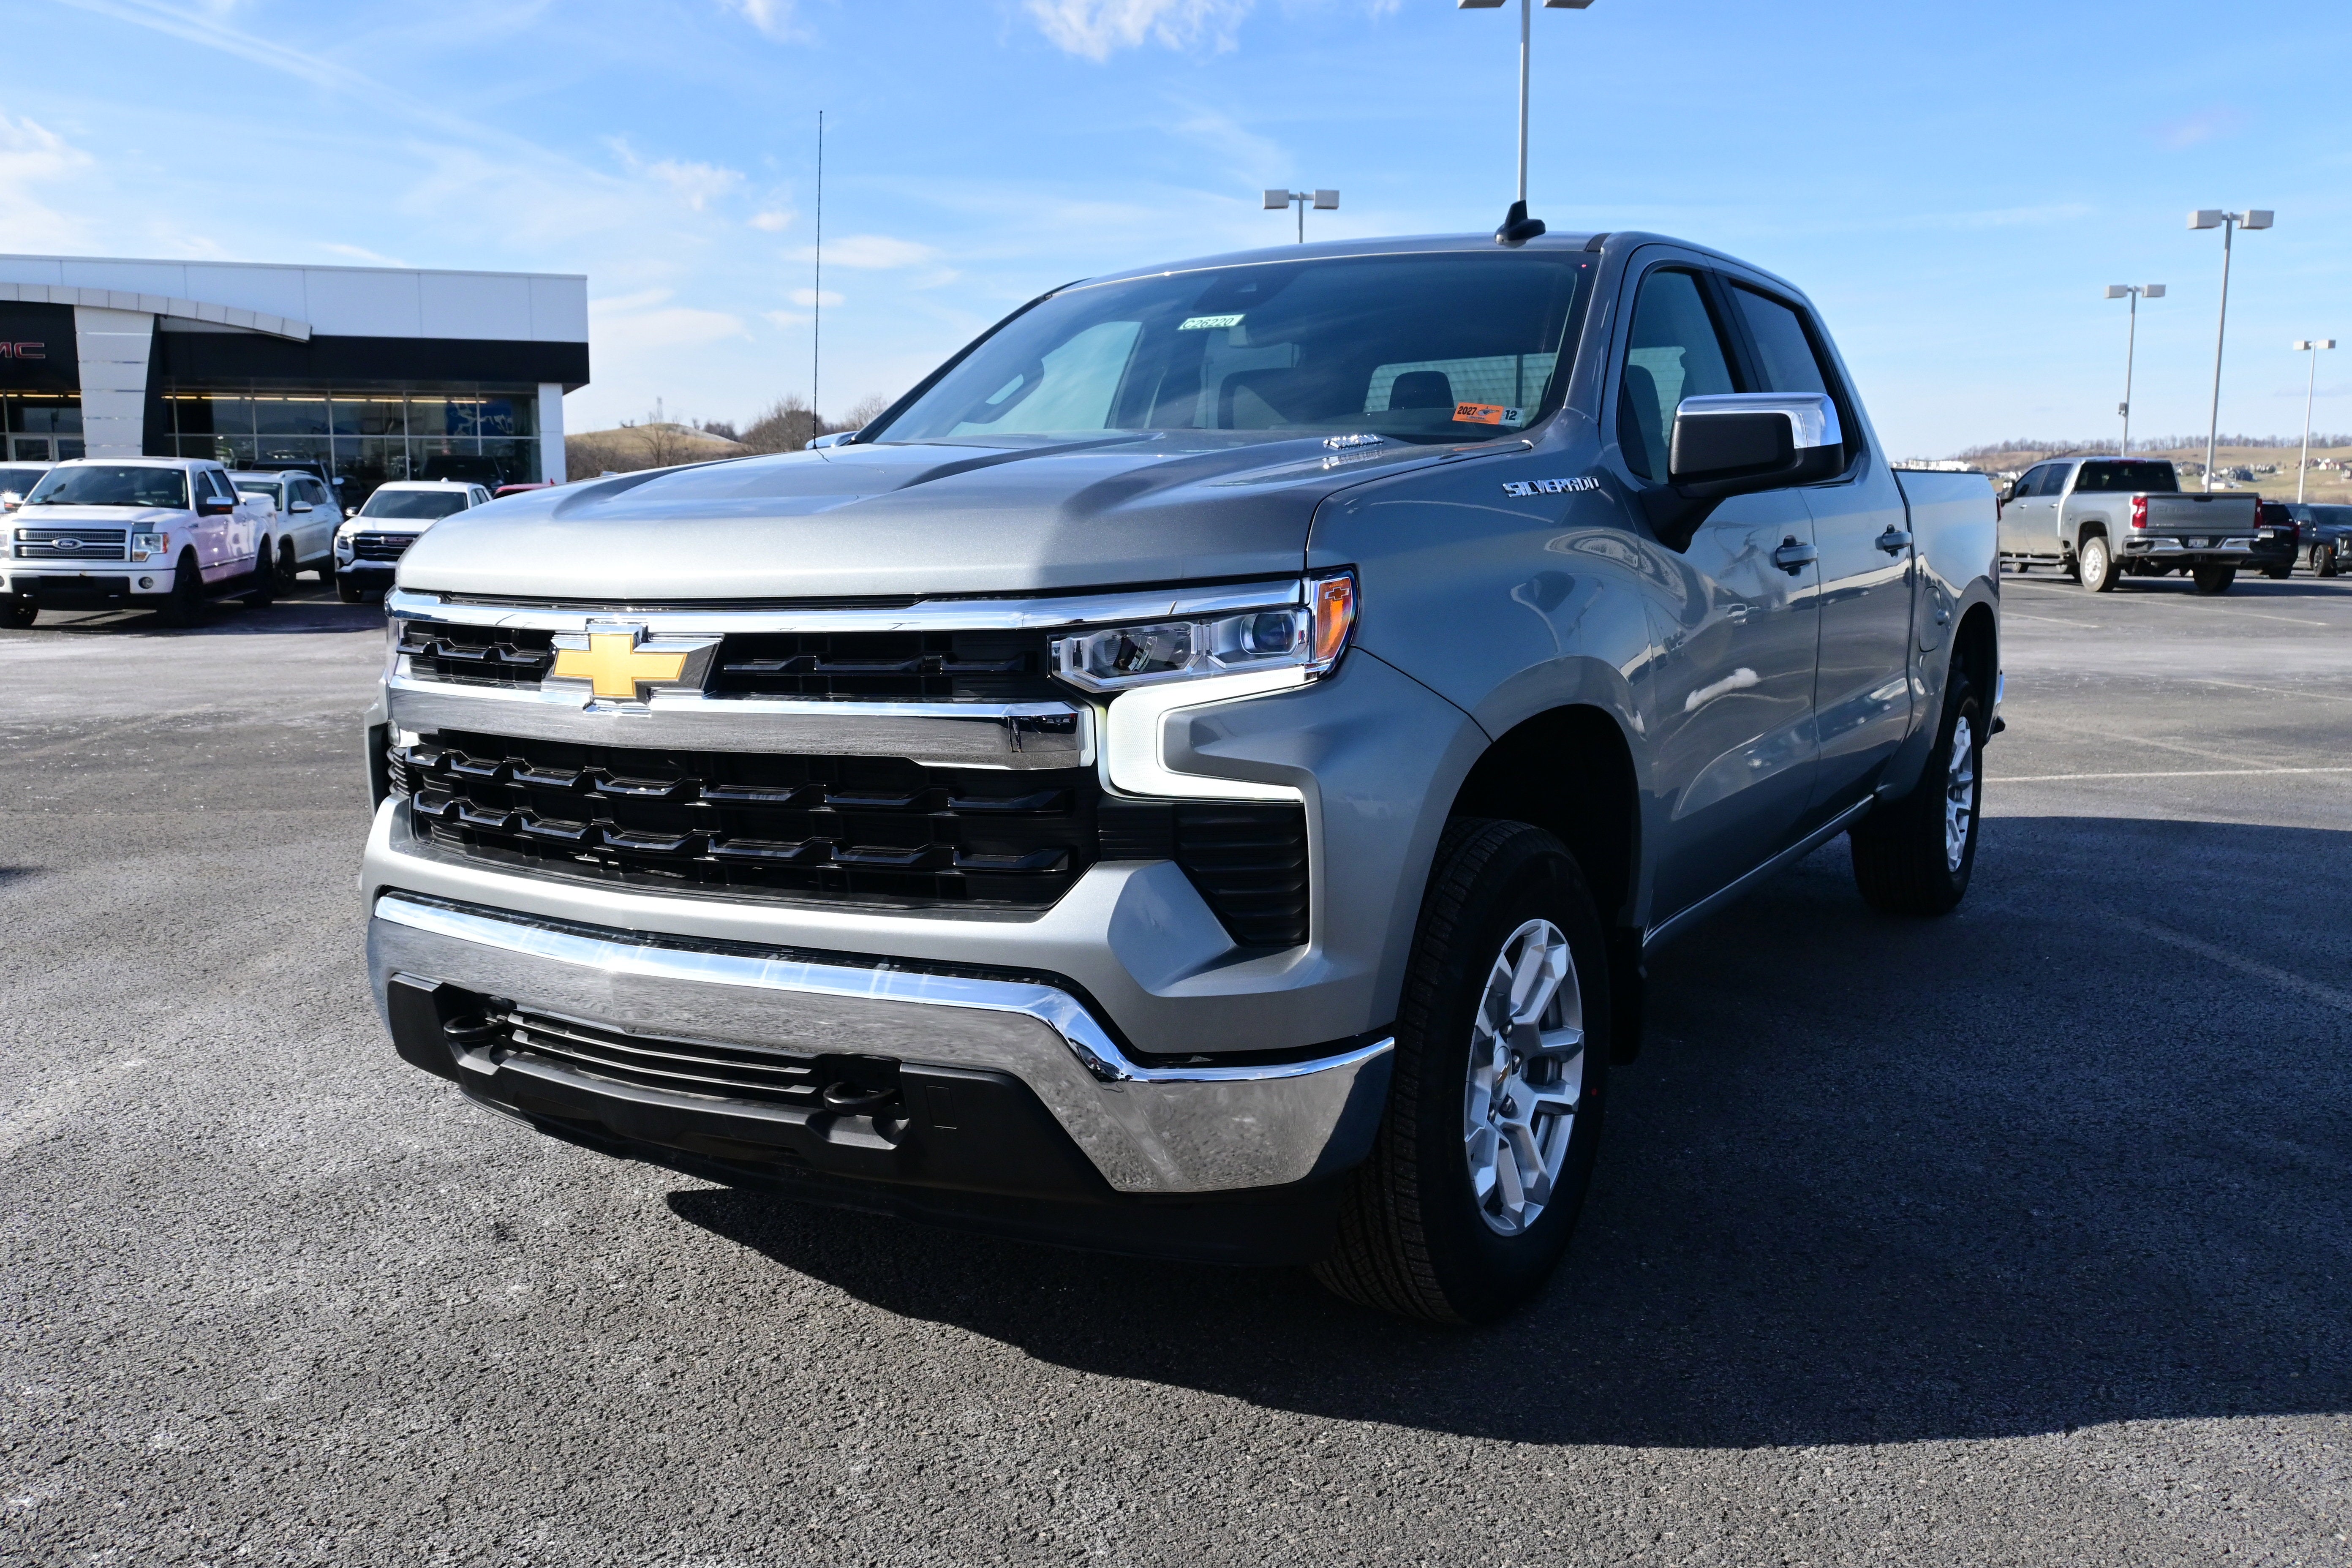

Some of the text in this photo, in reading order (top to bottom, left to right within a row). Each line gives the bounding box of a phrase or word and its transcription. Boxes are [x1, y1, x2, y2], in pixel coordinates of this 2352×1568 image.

[1183, 318, 1234, 328] C26220
[1457, 406, 1517, 420] 2027 12
[1503, 476, 1601, 498] SILVERADO
